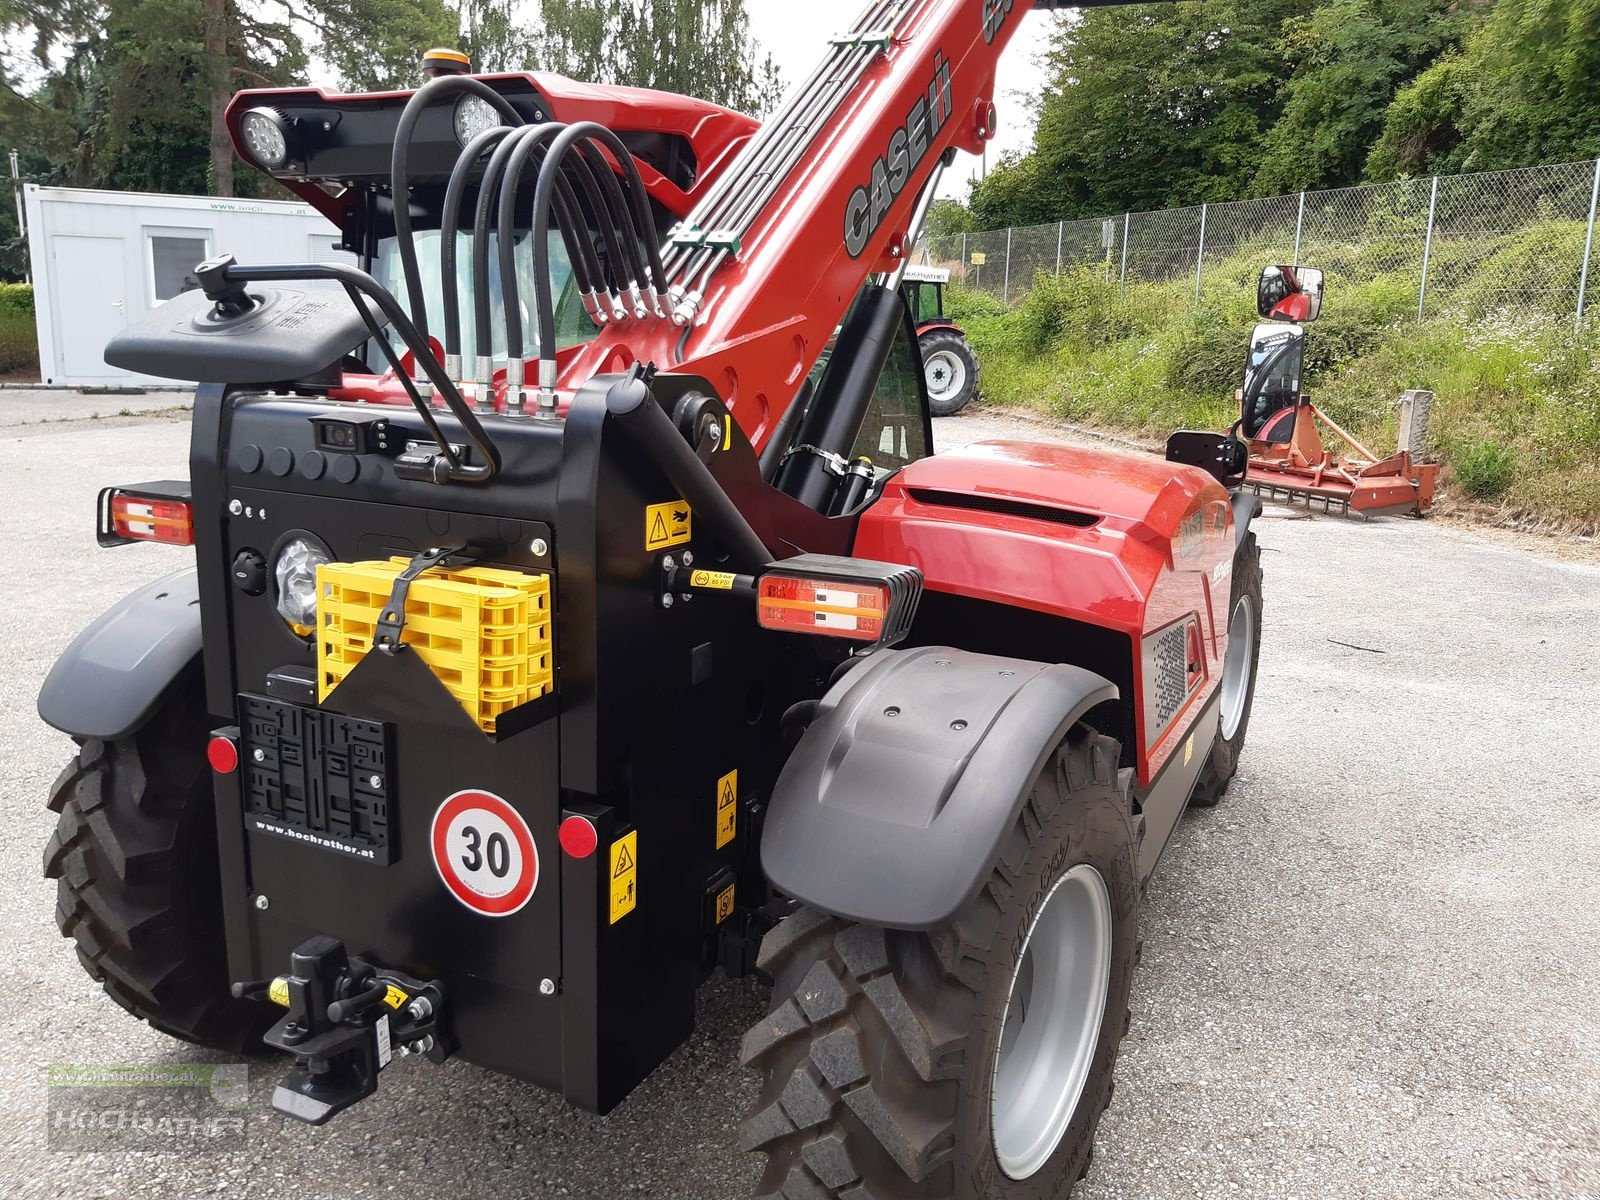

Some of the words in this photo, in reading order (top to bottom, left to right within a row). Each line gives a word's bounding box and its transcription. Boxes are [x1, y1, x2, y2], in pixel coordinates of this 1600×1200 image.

[844, 94, 928, 259] CASE
[256, 821, 375, 859] www.hochrather.at
[461, 825, 511, 878] 30
